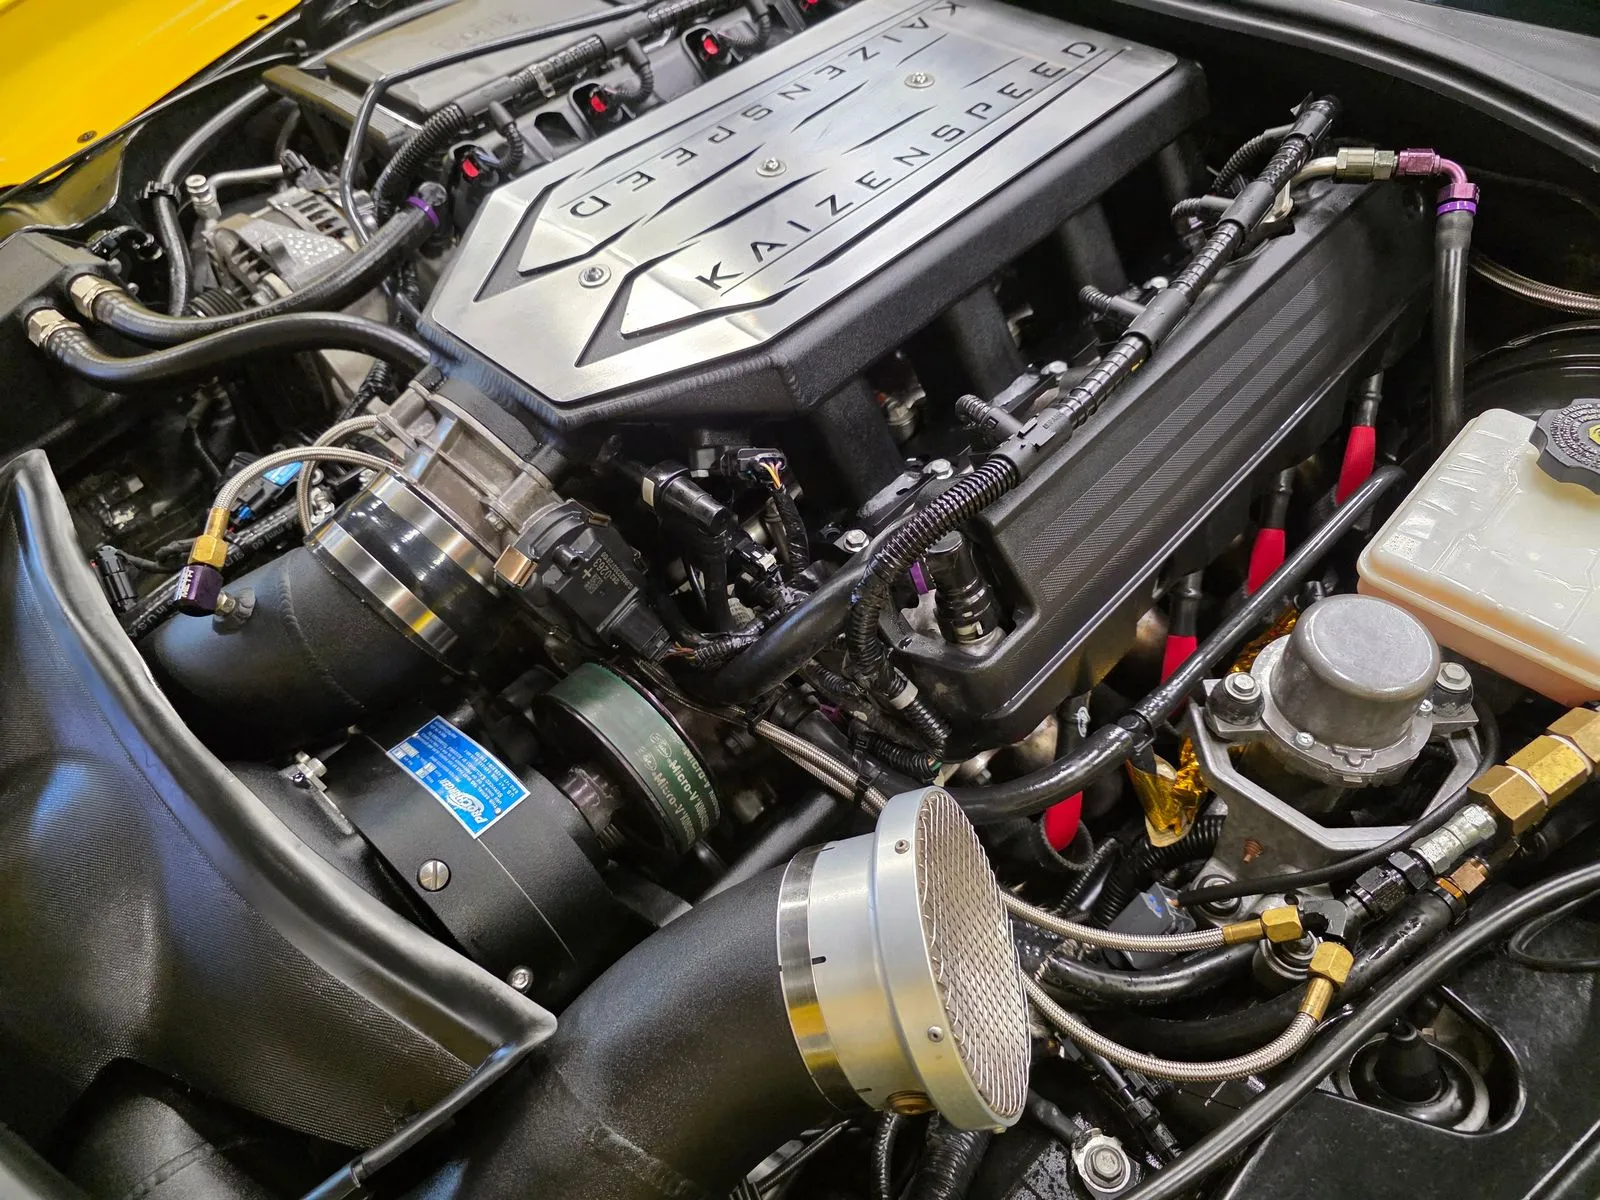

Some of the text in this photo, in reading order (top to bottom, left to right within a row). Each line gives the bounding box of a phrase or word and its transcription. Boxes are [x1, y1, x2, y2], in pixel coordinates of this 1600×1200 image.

[570, 0, 966, 218] KAIZENSPEED
[695, 41, 1097, 290] KAIZENSPEED
[653, 772, 684, 815] Micro-V
[669, 759, 700, 801] Micro-V
